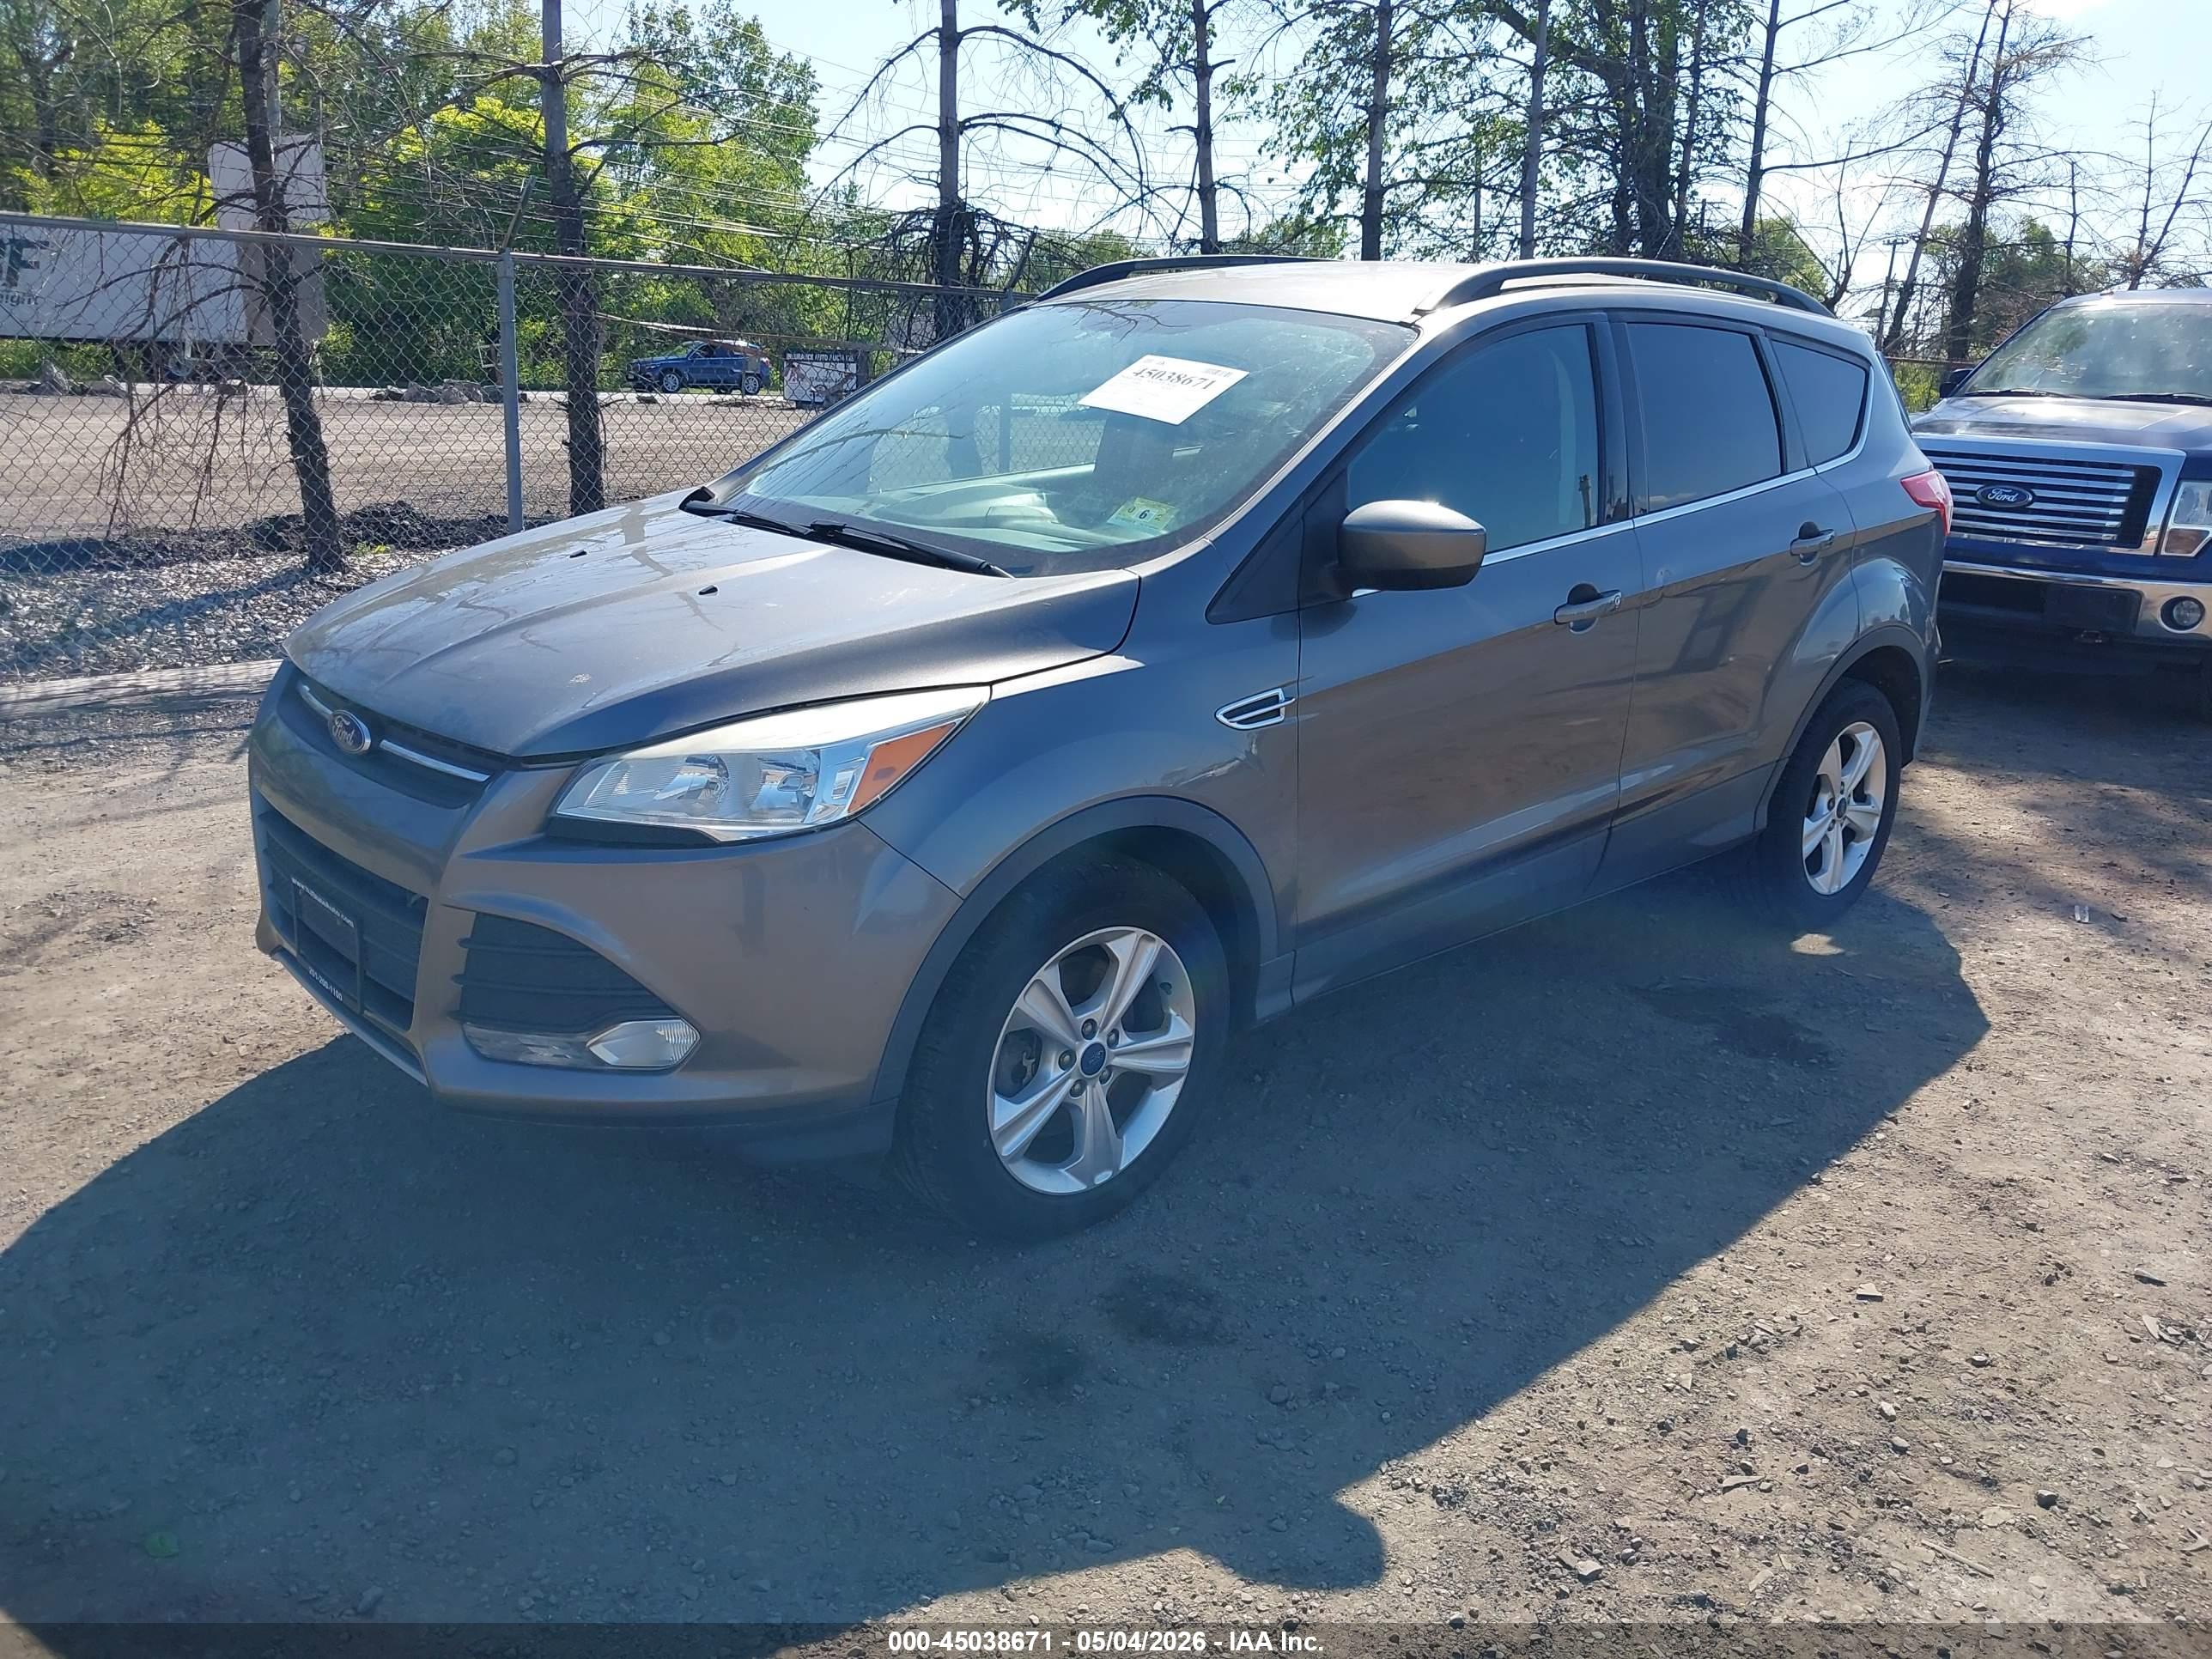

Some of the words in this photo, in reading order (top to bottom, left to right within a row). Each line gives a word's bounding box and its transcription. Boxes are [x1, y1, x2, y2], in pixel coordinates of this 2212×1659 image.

[1133, 367, 1217, 390] 45038671
[1987, 488, 2019, 502] Ford
[1138, 509, 1151, 520] 6
[331, 715, 356, 746] Ford
